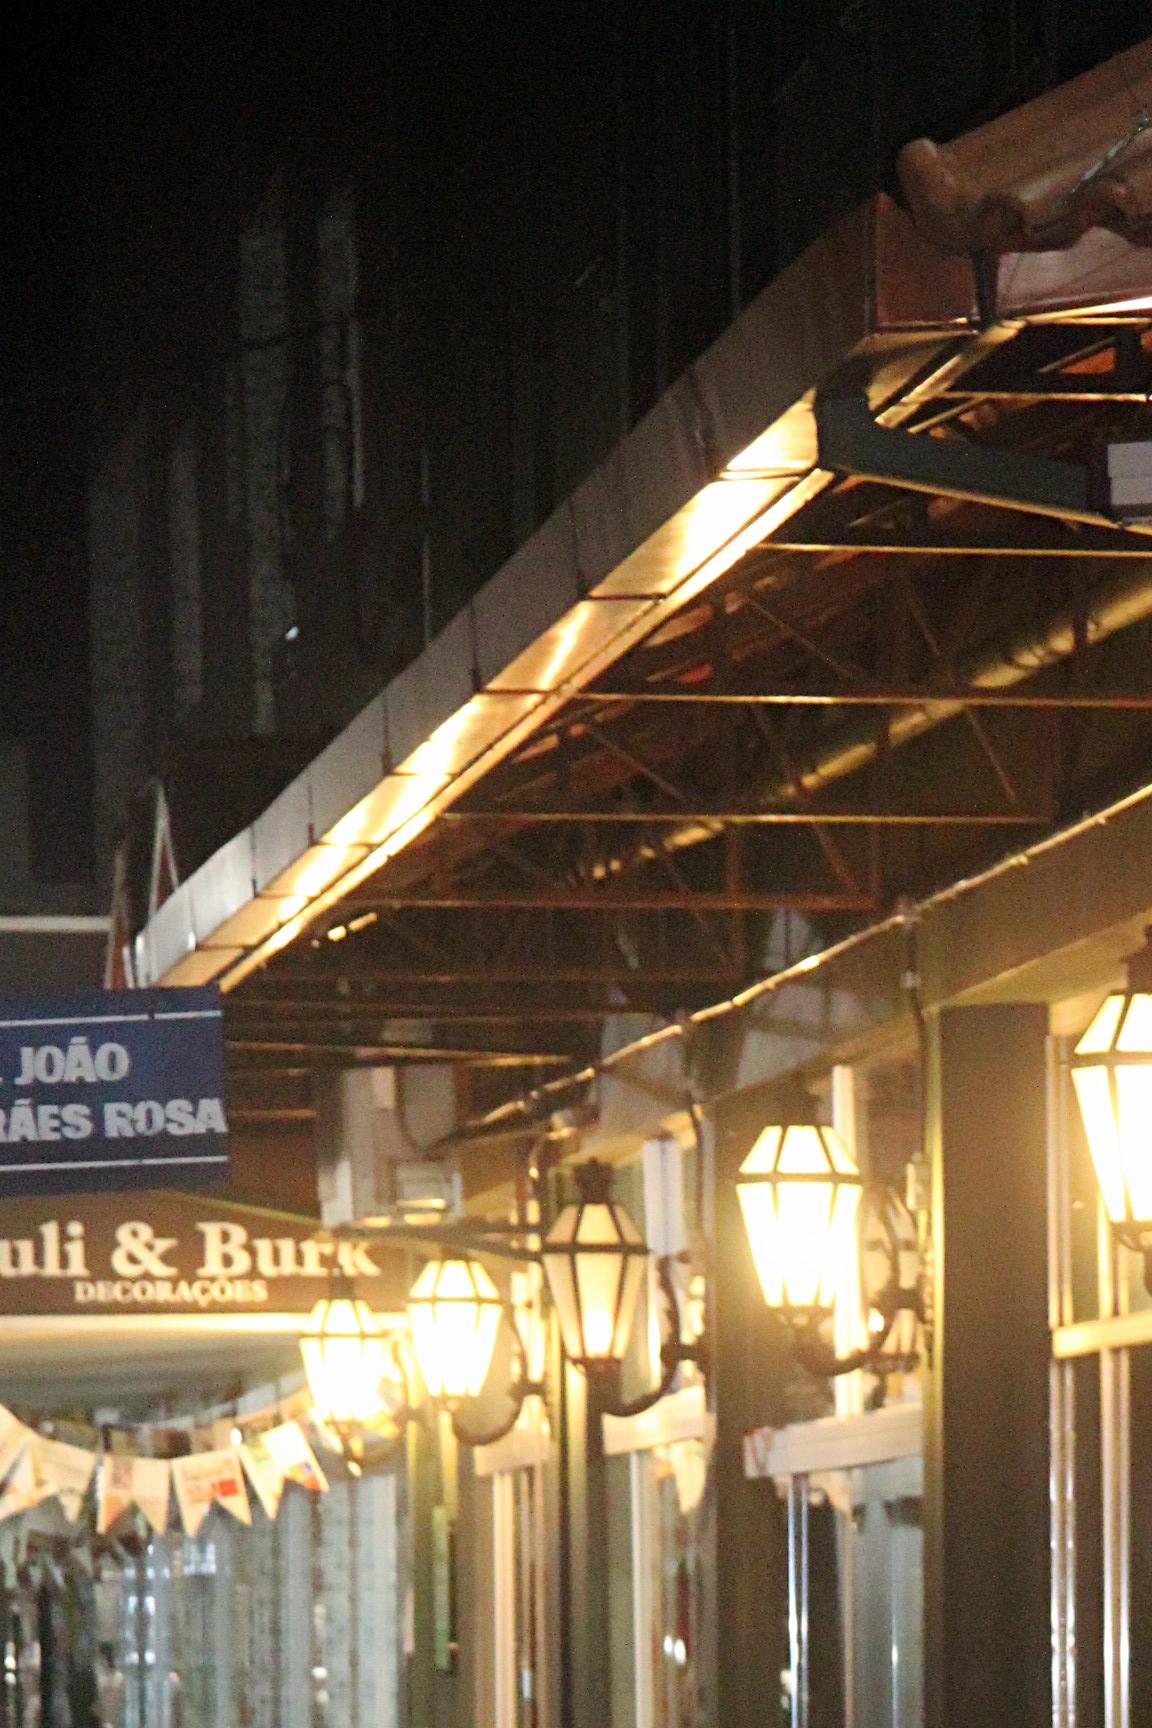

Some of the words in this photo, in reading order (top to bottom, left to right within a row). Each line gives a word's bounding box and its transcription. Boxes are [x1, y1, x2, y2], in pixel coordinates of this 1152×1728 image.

[14, 1035, 130, 1085] JOÃO
[0, 1098, 93, 1143] ÃES
[104, 1098, 228, 1138] ROSA
[110, 1221, 179, 1278] &
[74, 1277, 268, 1307] DECORAÇÕES
